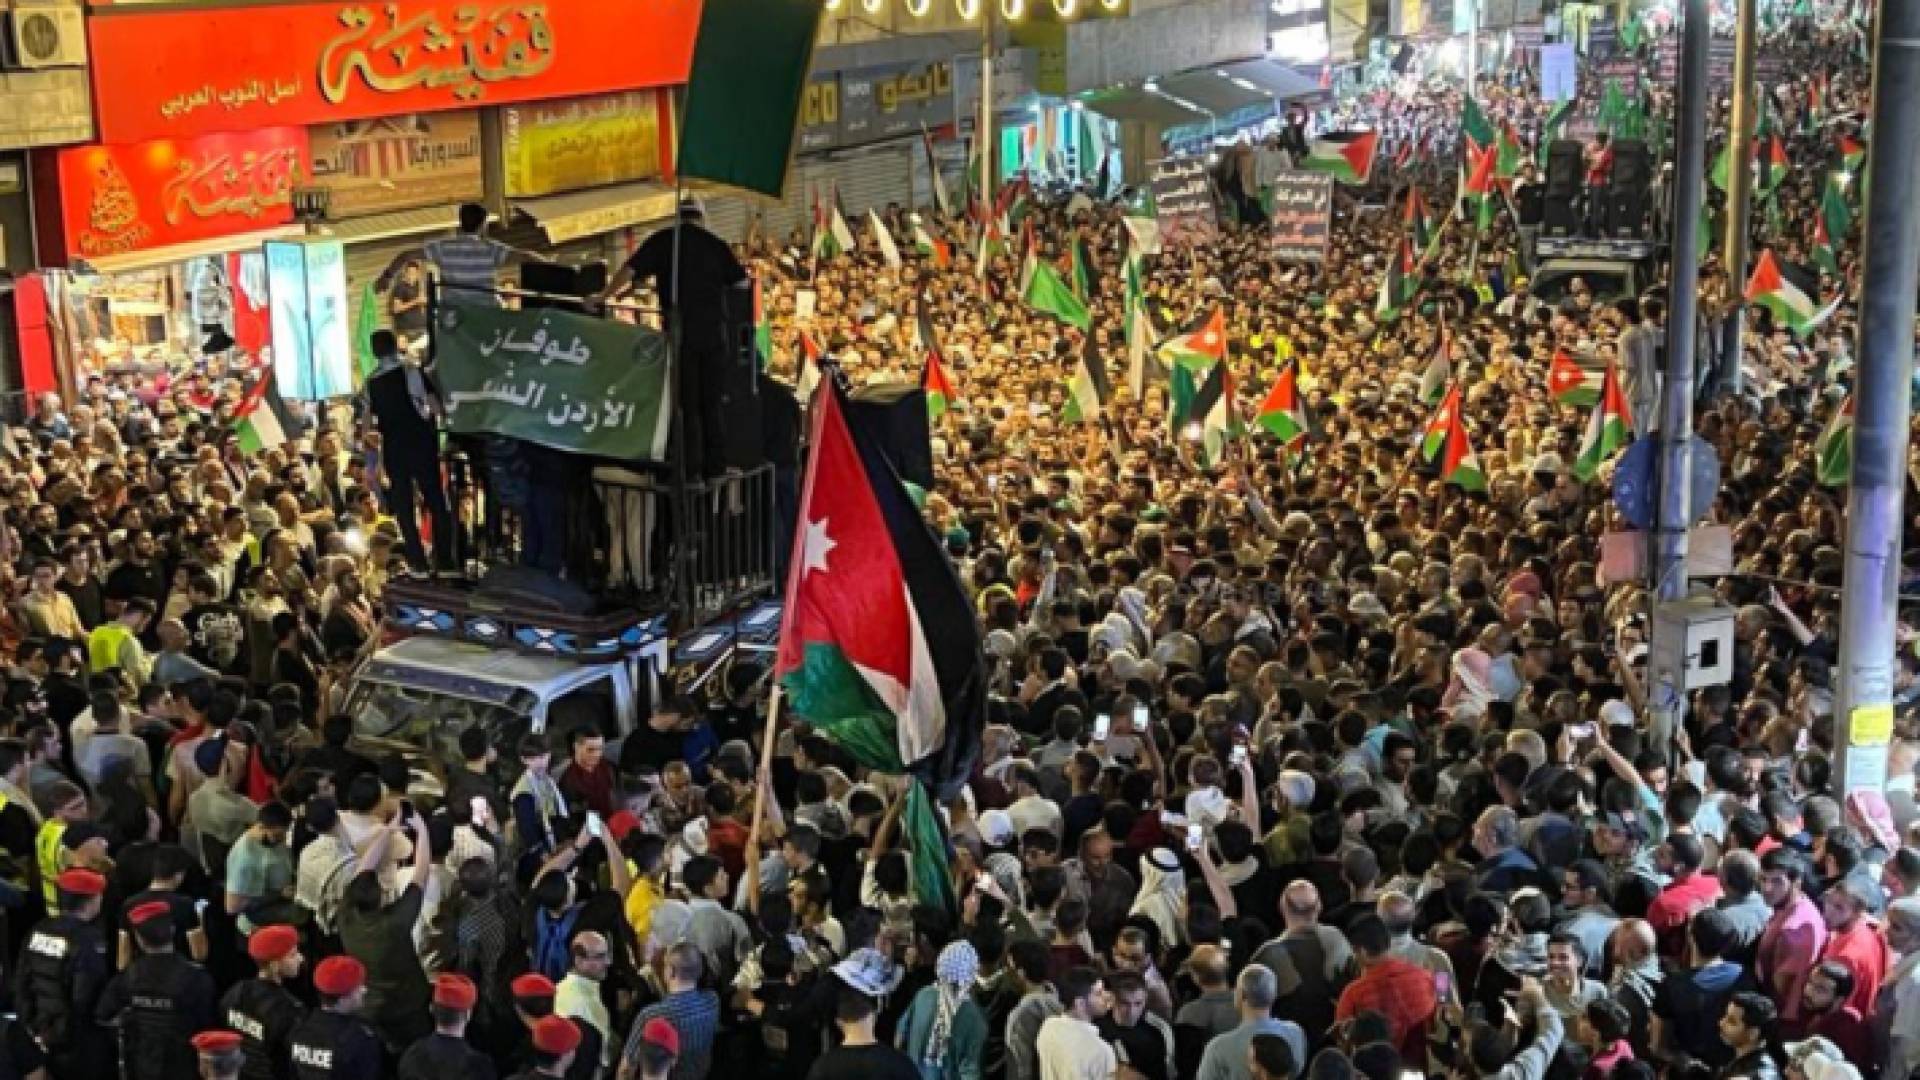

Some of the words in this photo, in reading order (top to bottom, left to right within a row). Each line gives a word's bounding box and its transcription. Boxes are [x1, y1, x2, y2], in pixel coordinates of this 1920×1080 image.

[480, 317, 591, 366] طوفان
[546, 384, 636, 432] الأردن
[227, 1008, 264, 1041] POLICE
[291, 1043, 333, 1070] POLICE
